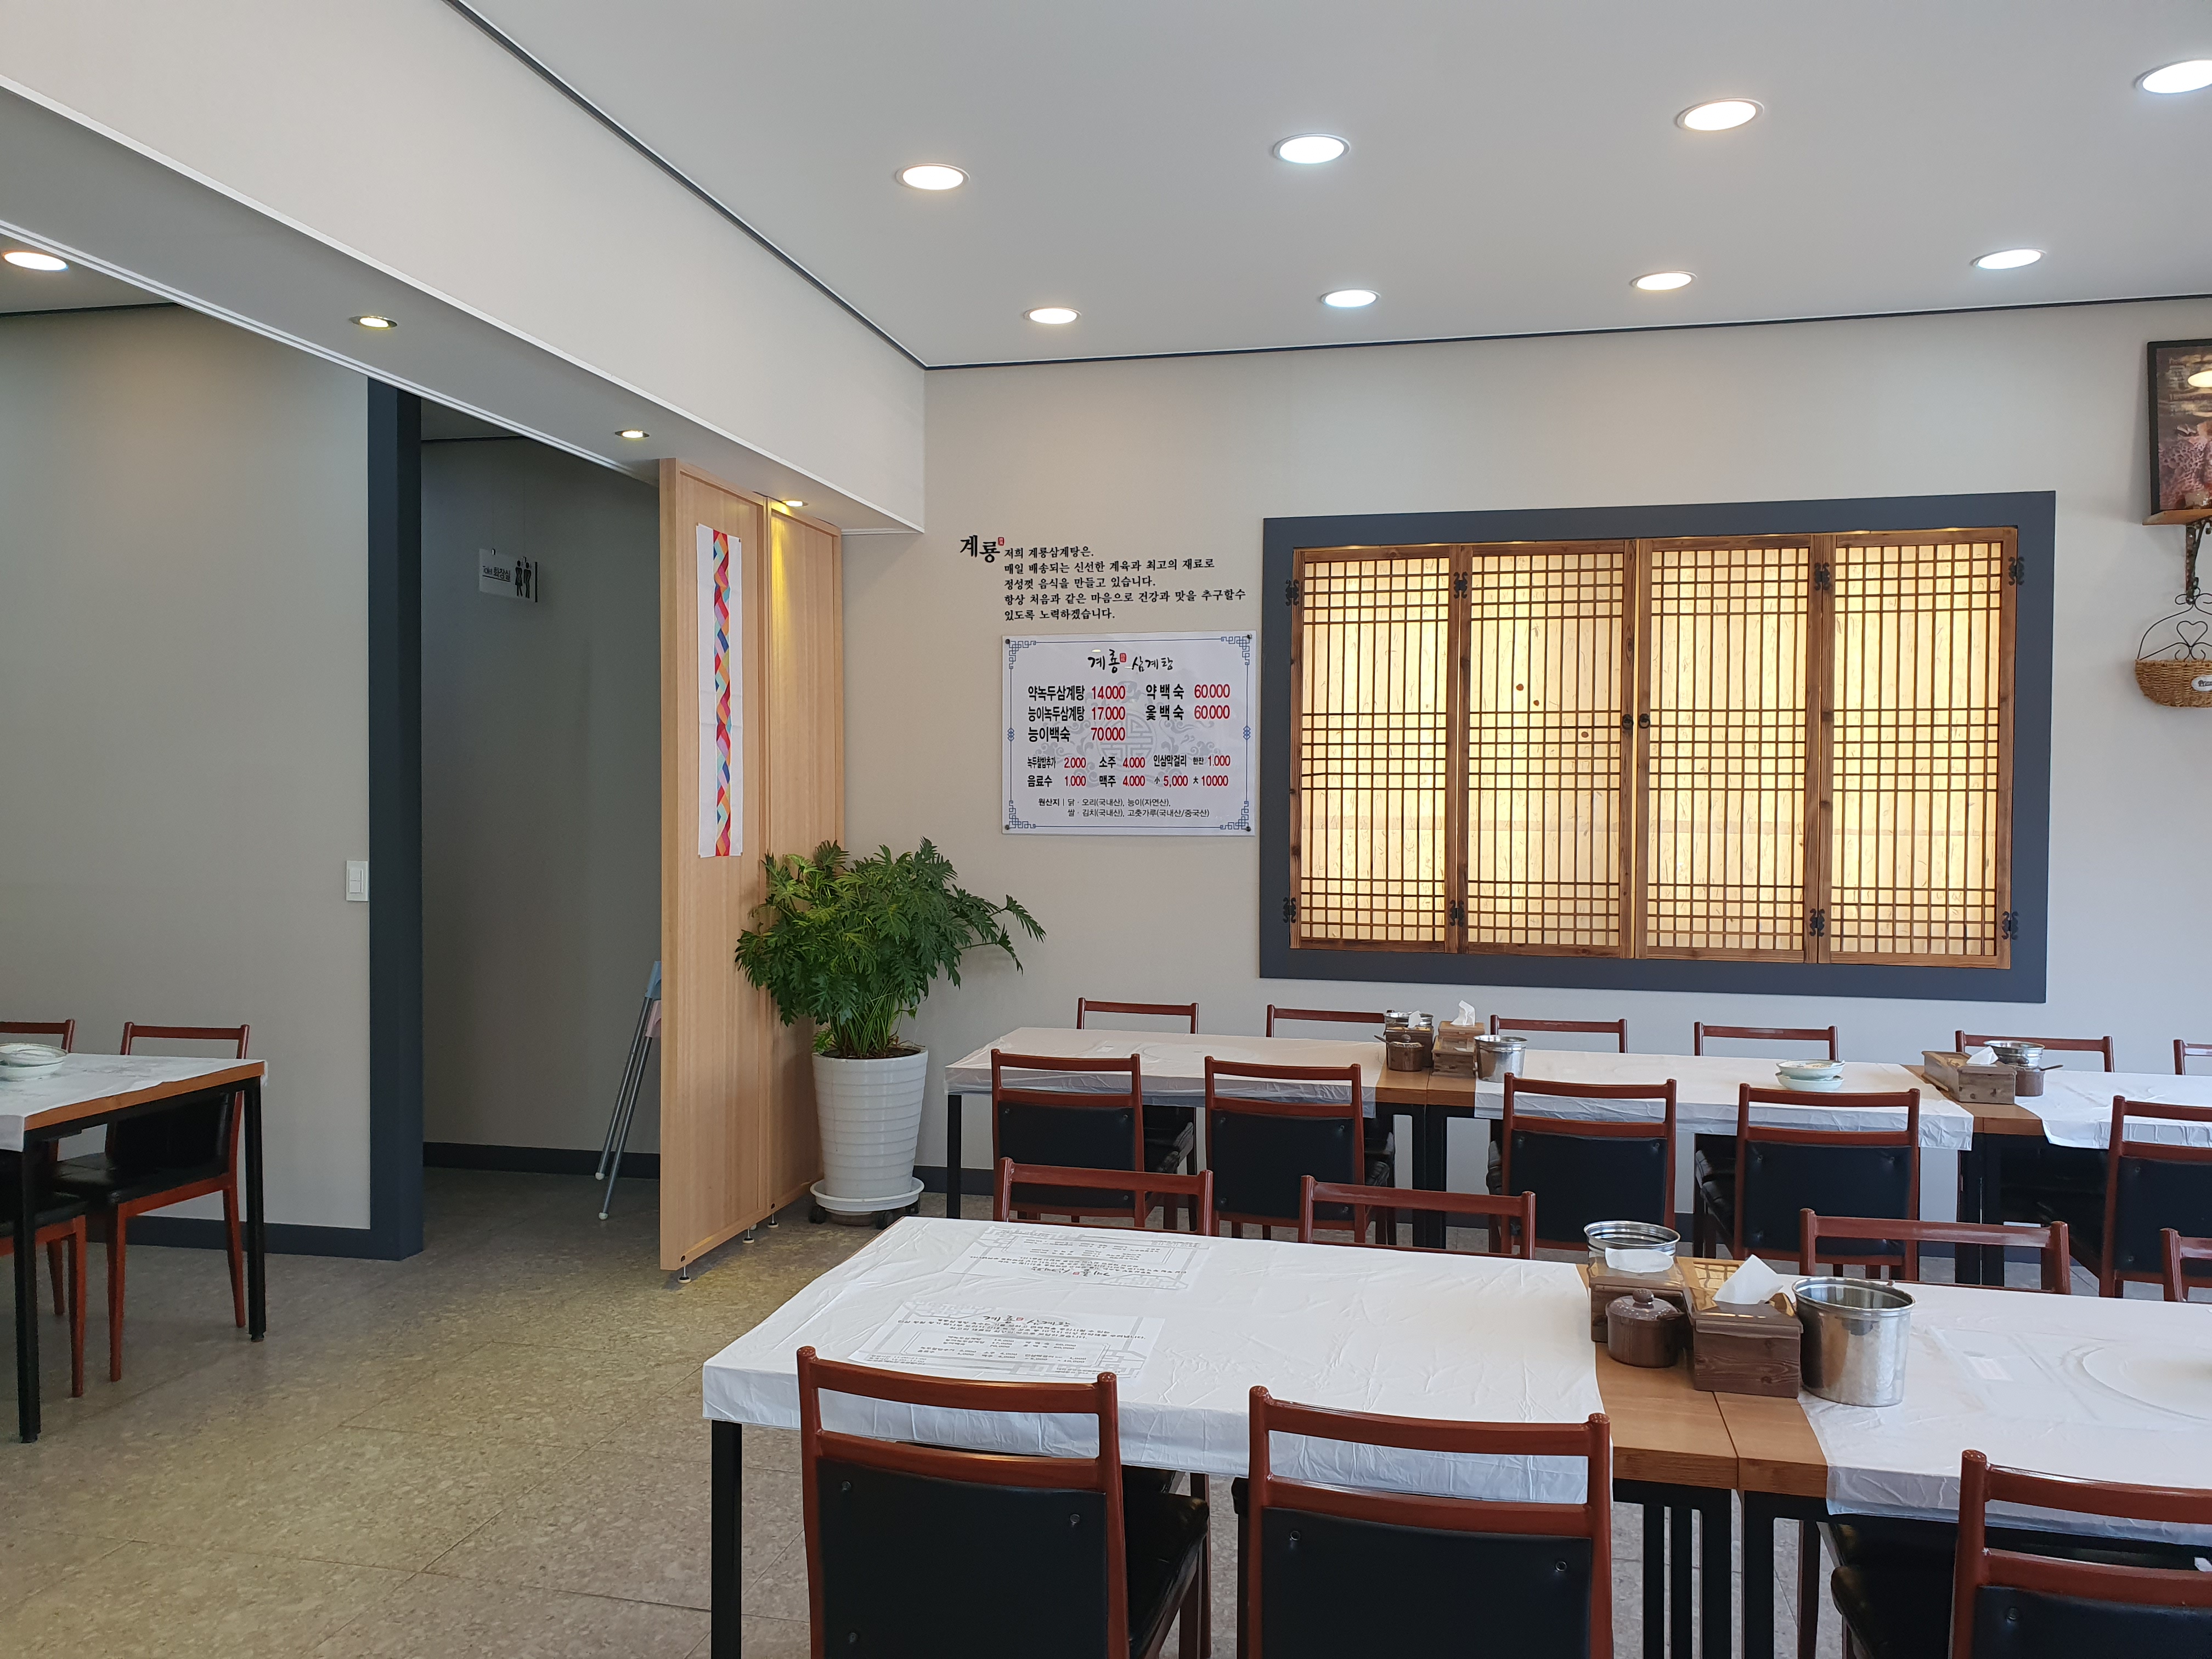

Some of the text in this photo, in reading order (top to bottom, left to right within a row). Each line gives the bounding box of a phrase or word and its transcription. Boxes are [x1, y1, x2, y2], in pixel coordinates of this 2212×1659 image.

[960, 535, 1000, 563] 계룡
[1005, 548, 1023, 559] 저희
[1005, 558, 1214, 574] 매일 배송되는 신선한 계육과 최고의 재료로
[1005, 575, 1155, 590] 정성껏 음식을 만들고 있습니다.
[1005, 594, 1025, 605] 항상
[1030, 594, 1060, 605] 처음과
[1065, 593, 1086, 603] 같은
[1091, 592, 1133, 603] 마음으로
[1139, 591, 1170, 602] 건강과
[1175, 590, 1197, 601] 맛을
[1005, 608, 1114, 620] 있도록 노력하겠습니다.
[1087, 649, 1120, 674] 계룡
[1132, 656, 1173, 673] 삼계탕
[1028, 685, 1125, 701] 약녹두삼계탕 14,000
[1194, 684, 1230, 698] 60,000
[1028, 706, 1125, 721] 능이녹두삼계탕 17,000
[1194, 705, 1229, 719] 60,000
[1028, 726, 1125, 742] 능이백숙 70,000
[1099, 757, 1116, 768] 소주
[1123, 757, 1145, 768] 4,000
[1154, 755, 1186, 766] 인삼막걸리
[1208, 755, 1230, 766] 1,000
[1028, 775, 1052, 787] 음료수
[1065, 776, 1086, 786] 1,000
[1099, 775, 1116, 787] 맥주
[1123, 776, 1145, 786] 4,000
[1164, 776, 1188, 787] 5,000
